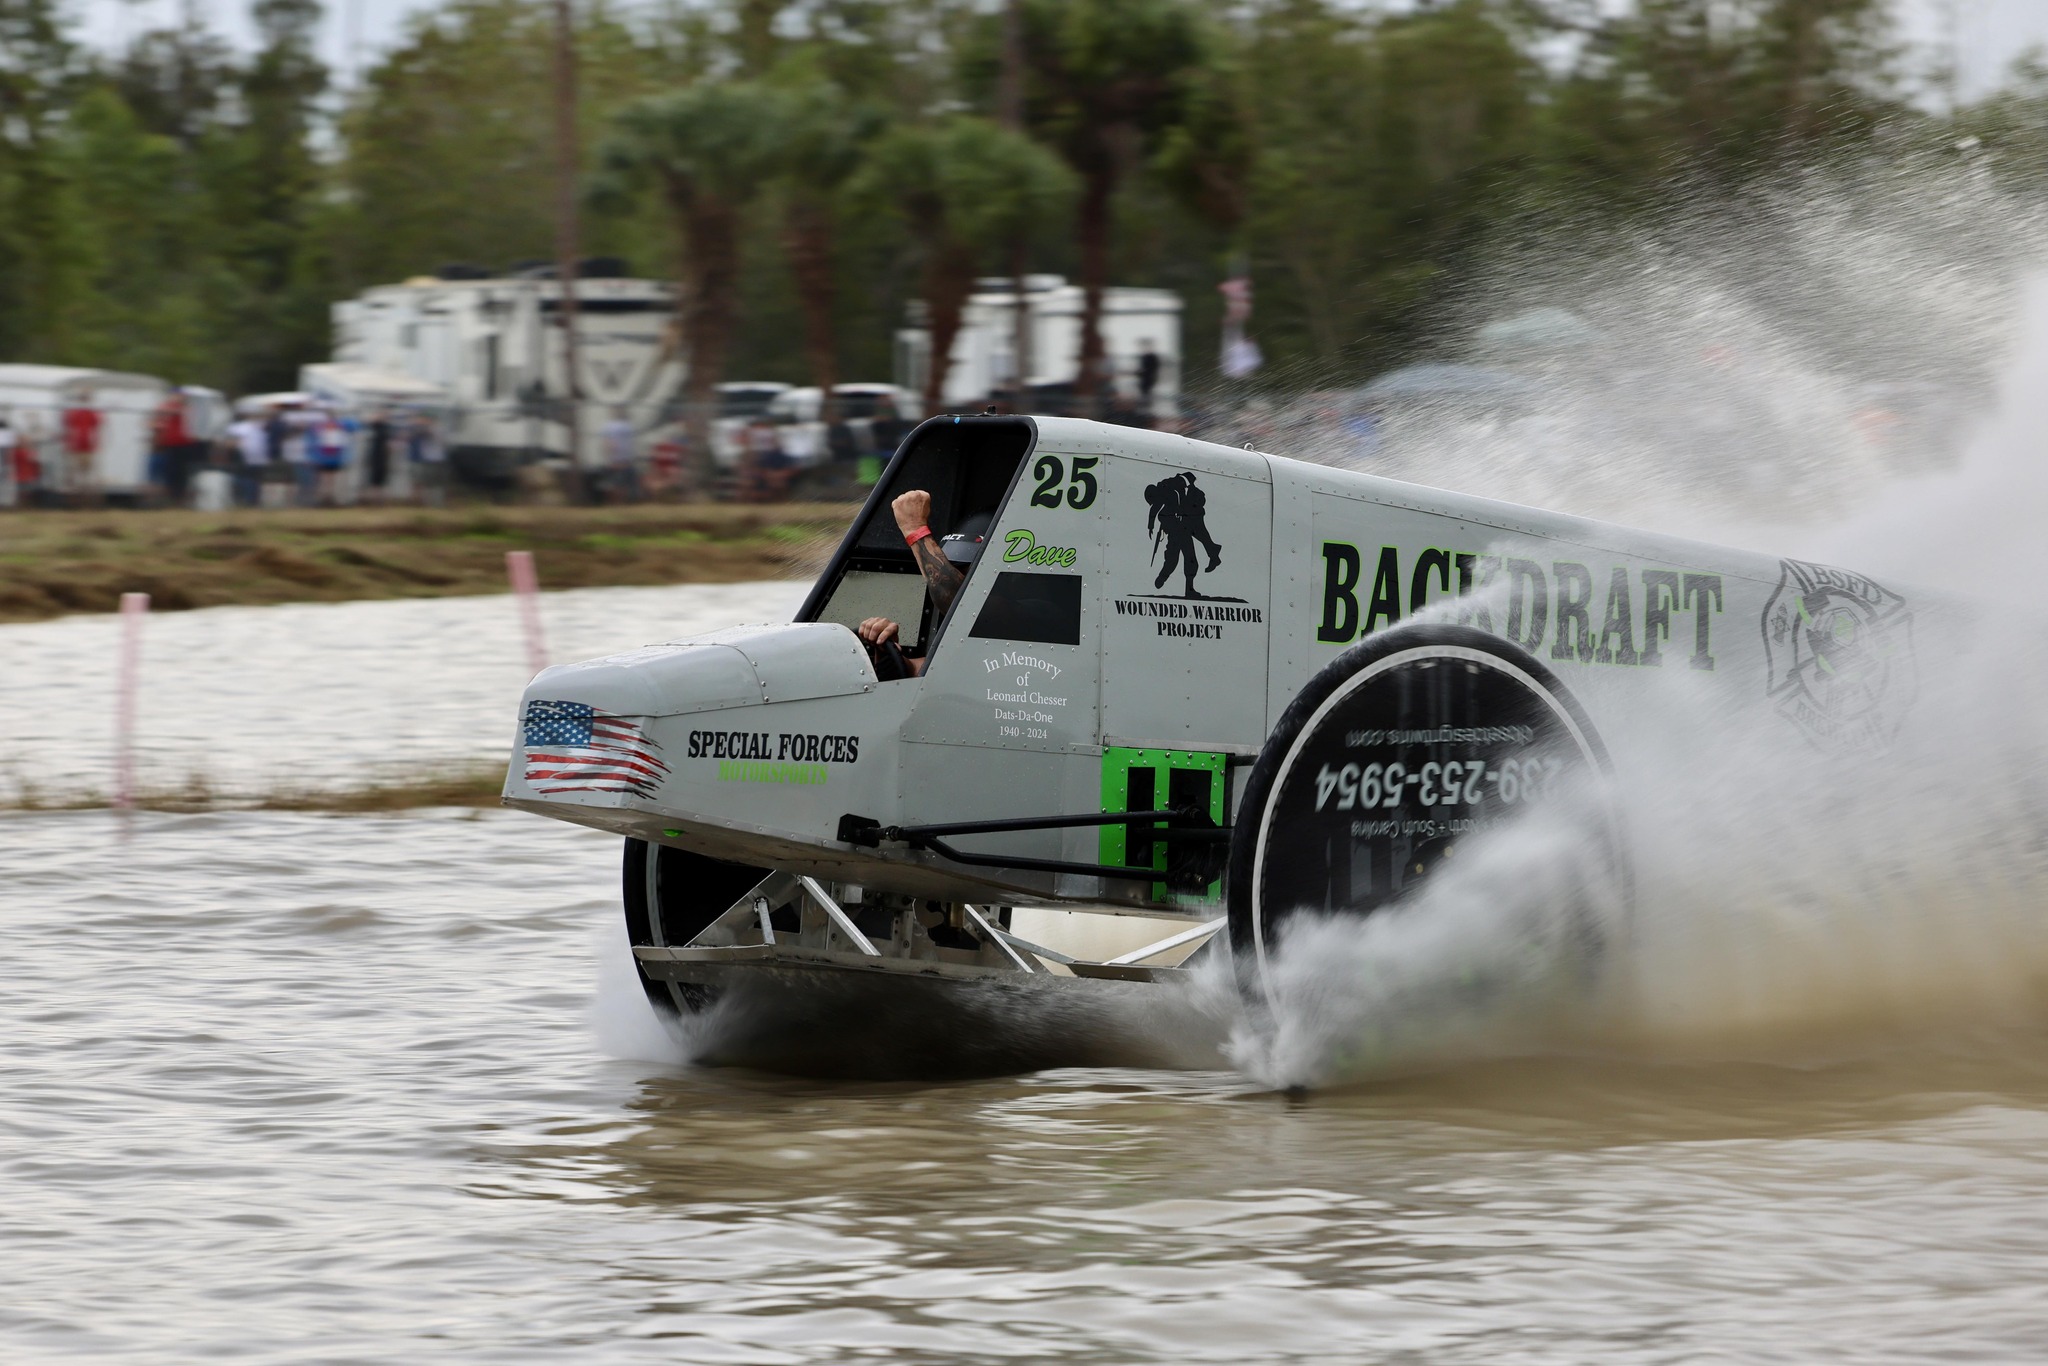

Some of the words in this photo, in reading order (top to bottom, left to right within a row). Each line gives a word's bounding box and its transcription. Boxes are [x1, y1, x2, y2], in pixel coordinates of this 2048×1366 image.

[1030, 455, 1098, 510] 25
[1002, 529, 1077, 568] Dave
[1114, 600, 1188, 619] WOUNDED
[1191, 607, 1263, 623] WARRIOR
[1316, 540, 1723, 671] BACKDRAFT
[1156, 621, 1223, 639] PROJECT
[982, 658, 1000, 673] In
[1002, 651, 1063, 680] Memory
[1016, 672, 1030, 687] of
[987, 688, 1027, 703] Leonard
[1029, 692, 1067, 706] Chesser
[995, 708, 1053, 723] Dats-Da-One
[999, 726, 1020, 737] 1940
[1027, 728, 1048, 739] 2024
[687, 730, 771, 760] SPECIAL
[778, 734, 859, 763] FORCES
[717, 760, 828, 784] MOTORSPORTS
[1314, 757, 1563, 812] 239-253-5954
[1350, 819, 1399, 839] Carolina
[1401, 819, 1437, 839] South
